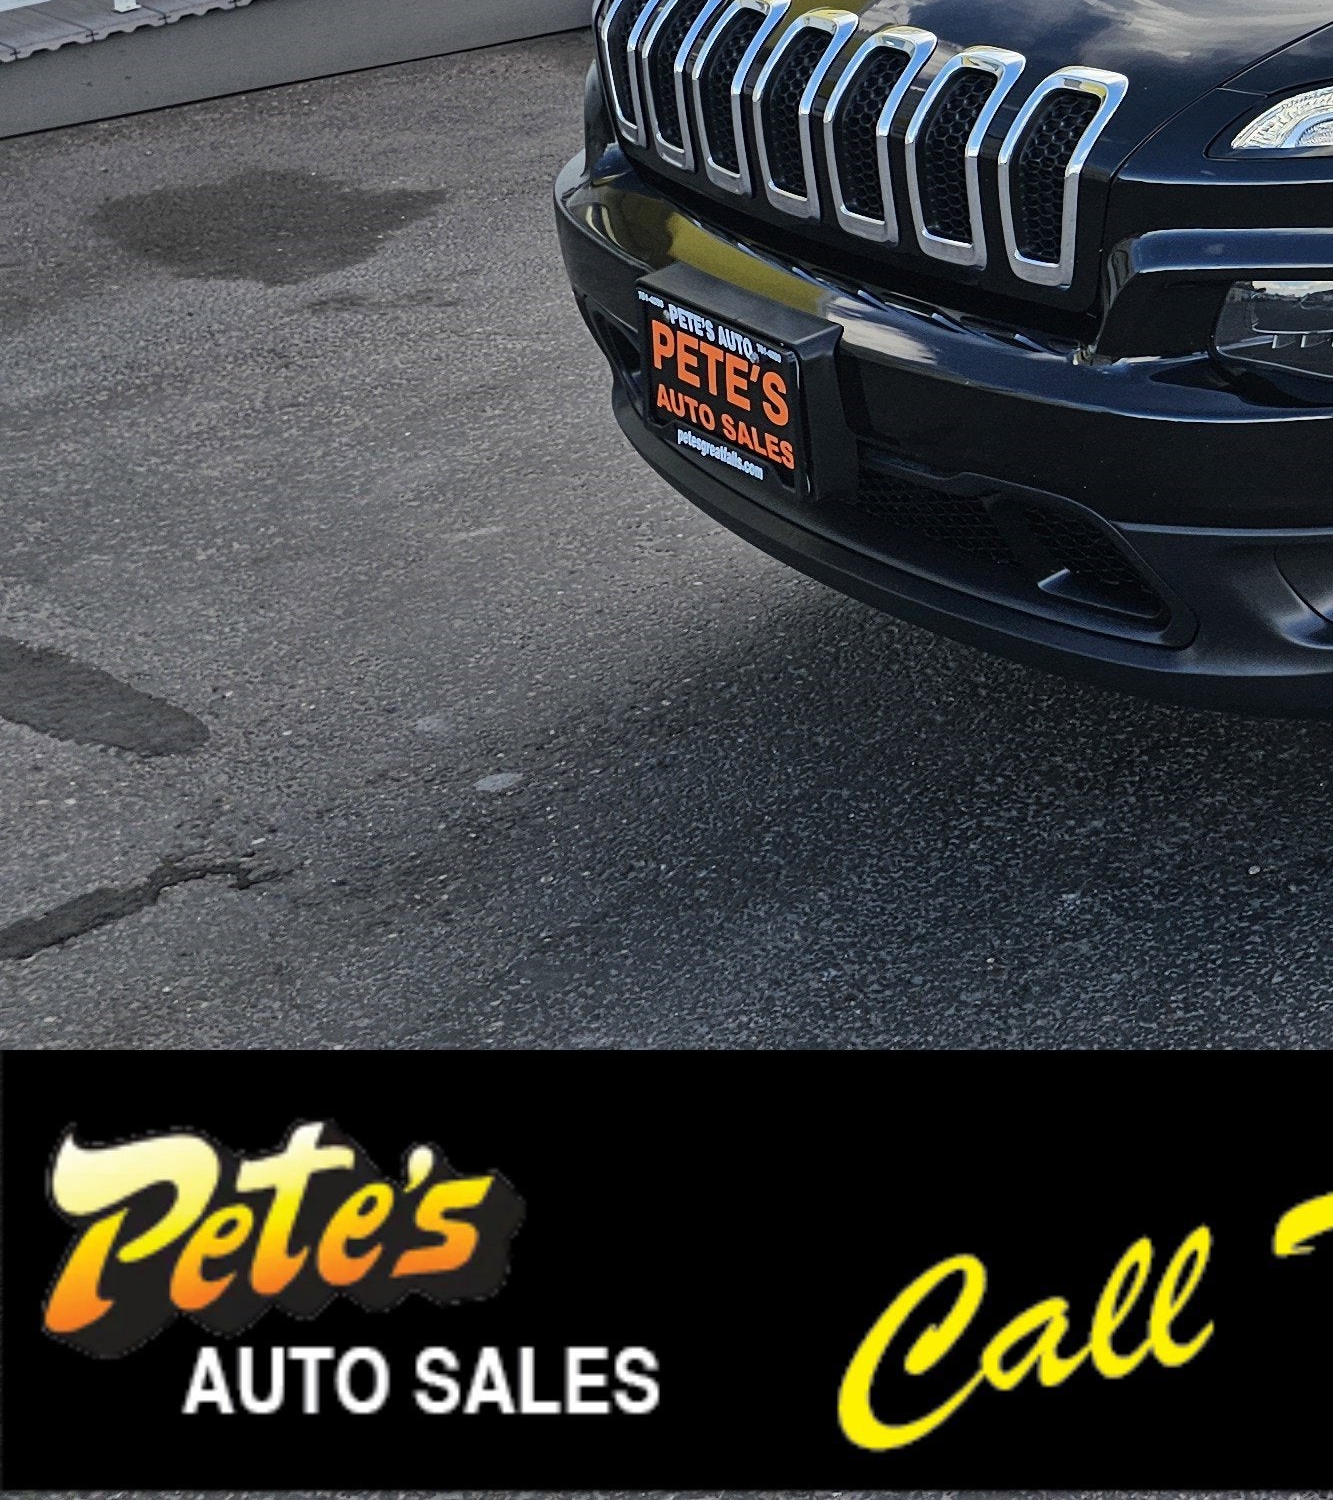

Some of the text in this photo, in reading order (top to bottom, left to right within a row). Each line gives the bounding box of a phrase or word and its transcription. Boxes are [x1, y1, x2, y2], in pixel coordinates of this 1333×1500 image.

[652, 319, 789, 426] PETE'S
[667, 303, 716, 342] PETE'S
[718, 325, 755, 360] AUTO
[656, 383, 795, 470] AUTO SALES
